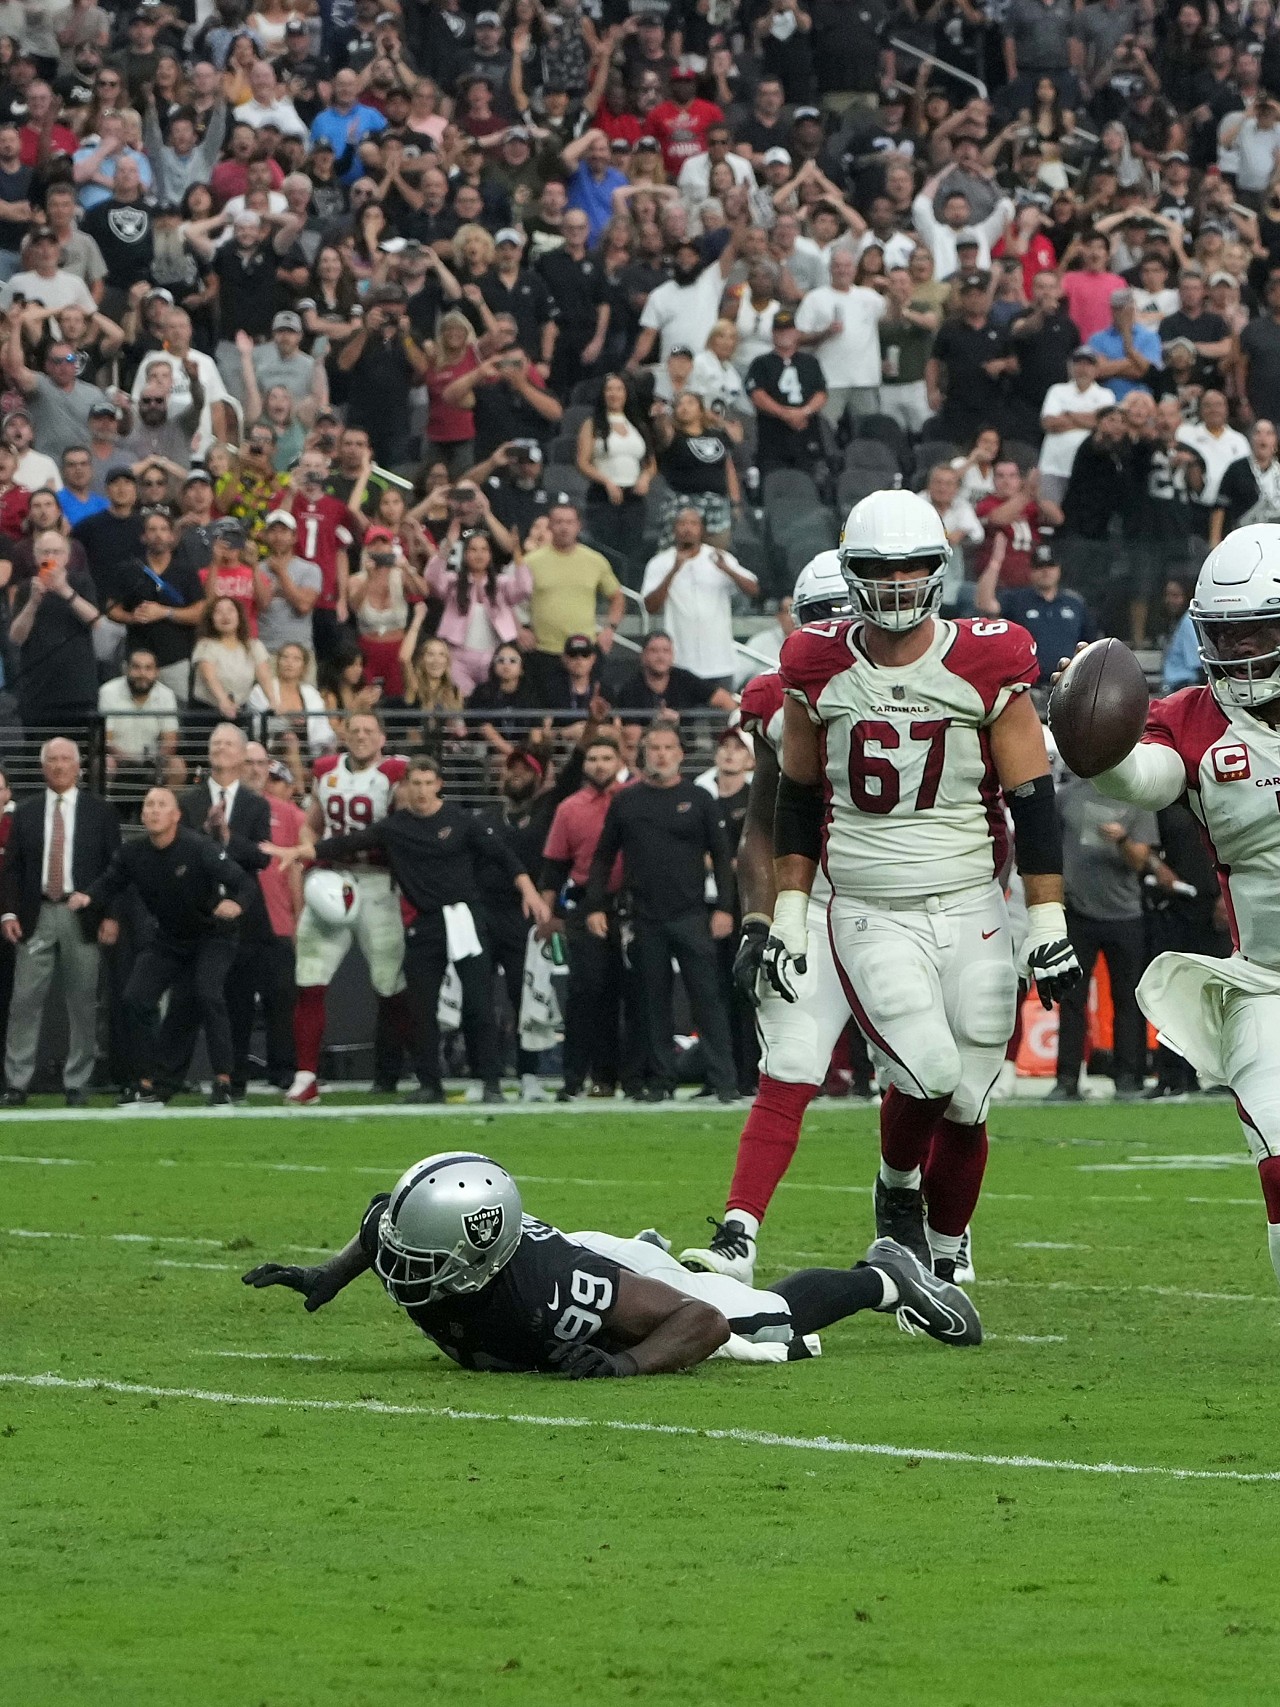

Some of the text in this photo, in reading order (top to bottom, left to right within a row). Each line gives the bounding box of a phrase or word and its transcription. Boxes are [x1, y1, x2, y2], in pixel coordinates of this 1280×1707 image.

[778, 366, 803, 405] 4
[304, 518, 319, 559] 1
[870, 705, 930, 713] CARDINALS
[849, 719, 951, 815] 67
[1214, 746, 1246, 773] C
[327, 795, 373, 836] 99
[467, 1208, 500, 1224] RAIDERS
[553, 1269, 613, 1343] 99
